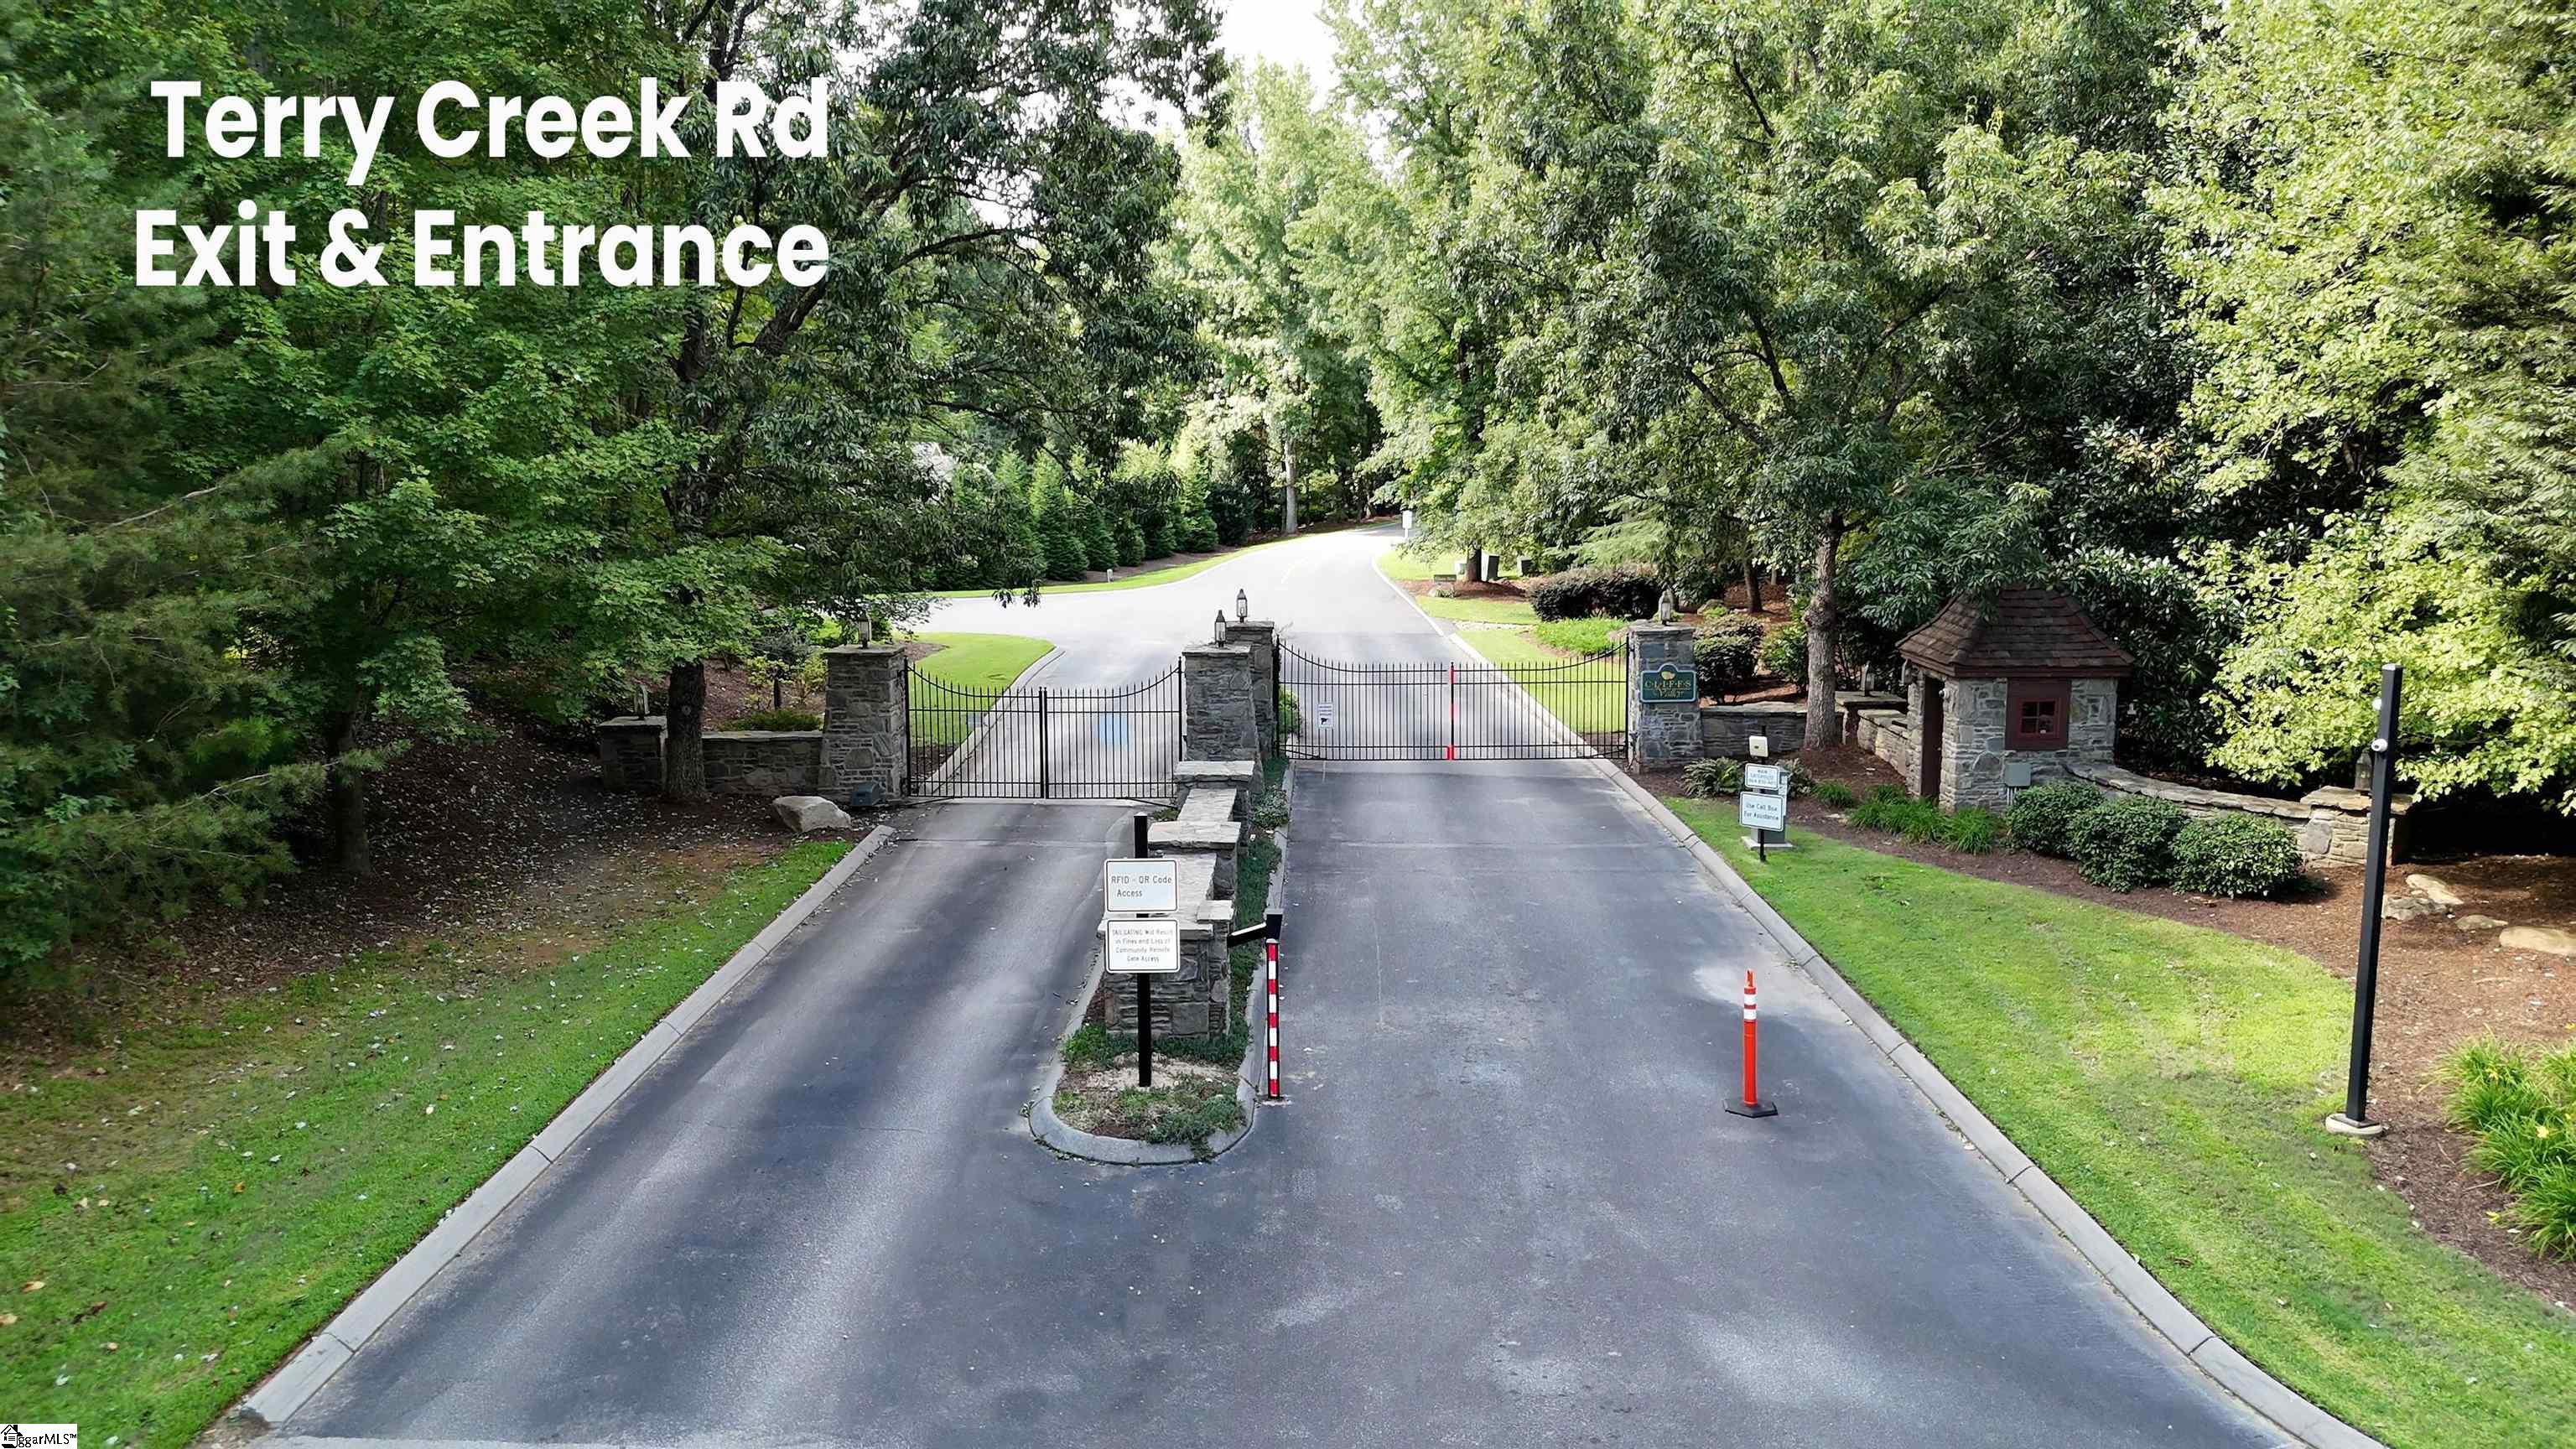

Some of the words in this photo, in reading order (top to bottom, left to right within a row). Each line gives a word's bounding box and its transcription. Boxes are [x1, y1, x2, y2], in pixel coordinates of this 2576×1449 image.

[1111, 875, 1130, 884] RFID
[1139, 875, 1150, 884] QR
[1152, 875, 1172, 884] Code
[1117, 889, 1143, 897] Access
